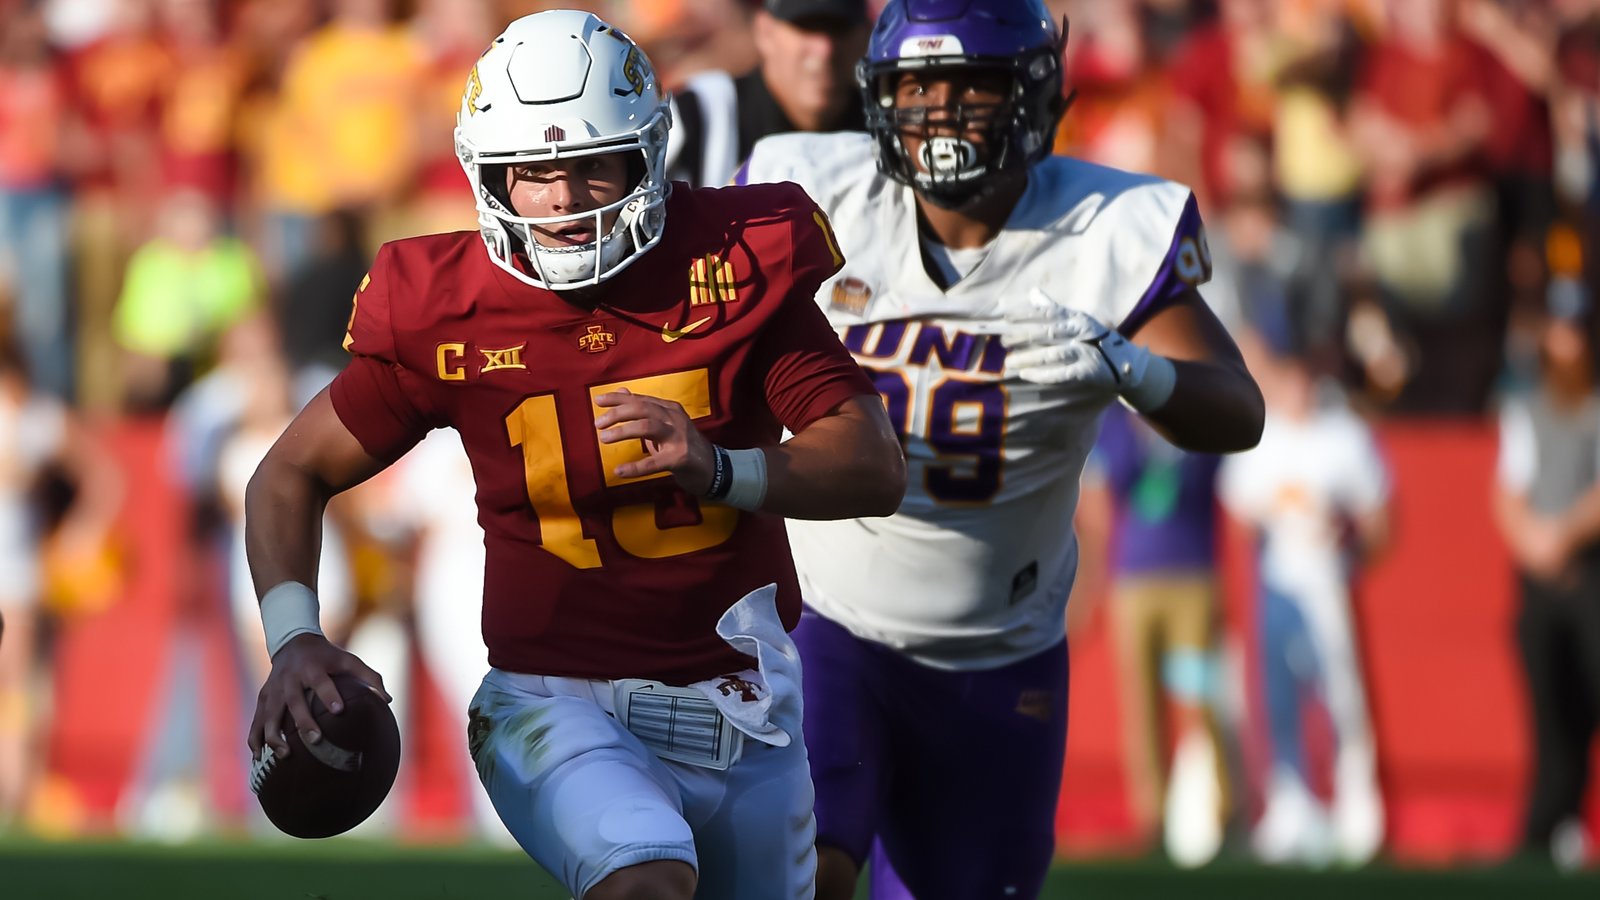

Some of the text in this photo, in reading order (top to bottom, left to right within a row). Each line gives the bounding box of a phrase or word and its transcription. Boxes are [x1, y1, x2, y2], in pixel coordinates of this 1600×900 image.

[482, 346, 525, 372] XII
[579, 332, 614, 347] STATE
[844, 322, 1007, 375] UNI
[436, 342, 466, 381] C
[505, 367, 740, 569] 15
